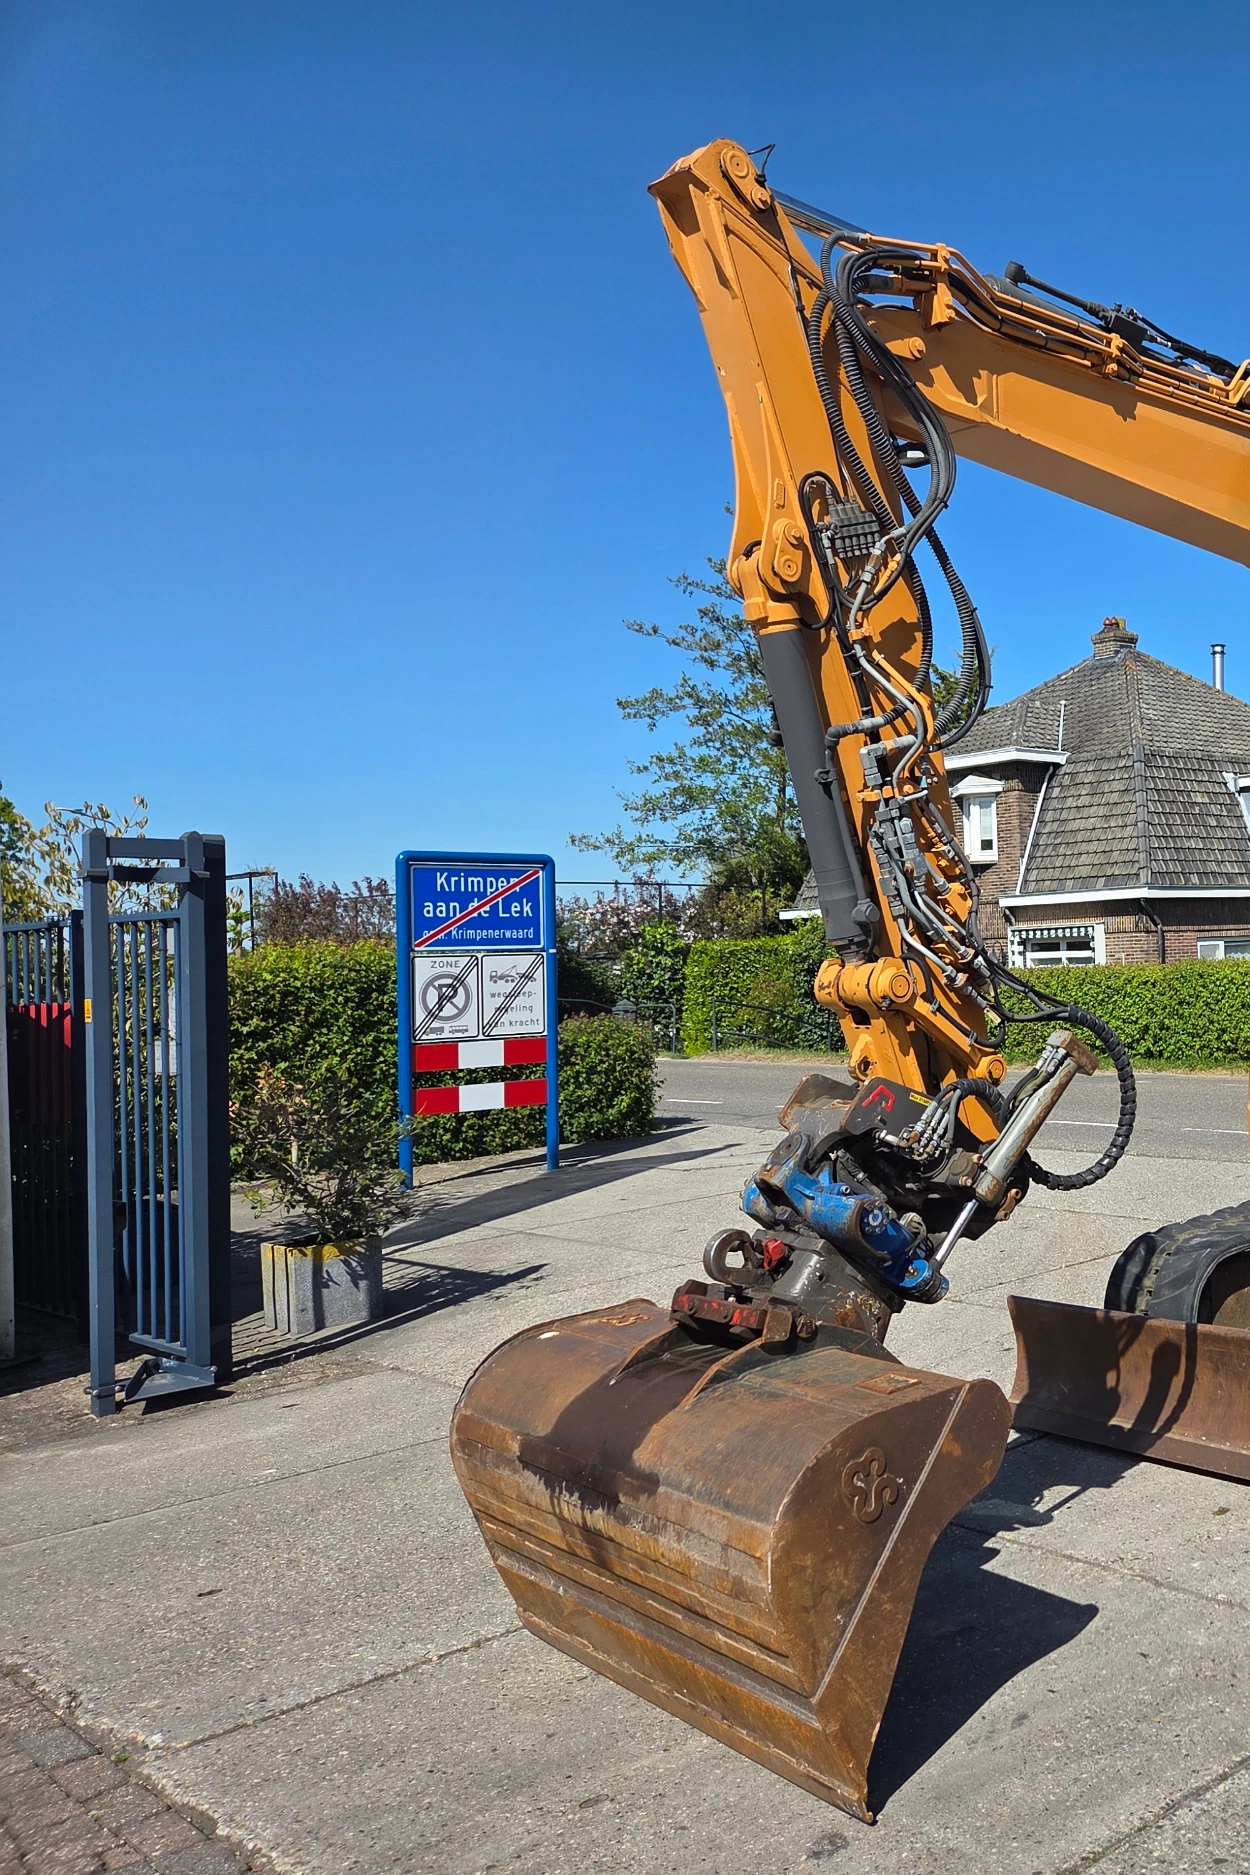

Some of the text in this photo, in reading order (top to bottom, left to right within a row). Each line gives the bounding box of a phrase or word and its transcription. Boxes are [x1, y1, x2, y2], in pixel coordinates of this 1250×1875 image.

[423, 901, 460, 918] aan
[499, 898, 533, 917] Lek
[451, 927, 534, 942] Krimpenerwaard
[430, 960, 461, 969] ZONE
[509, 1018, 540, 1027] kracht
